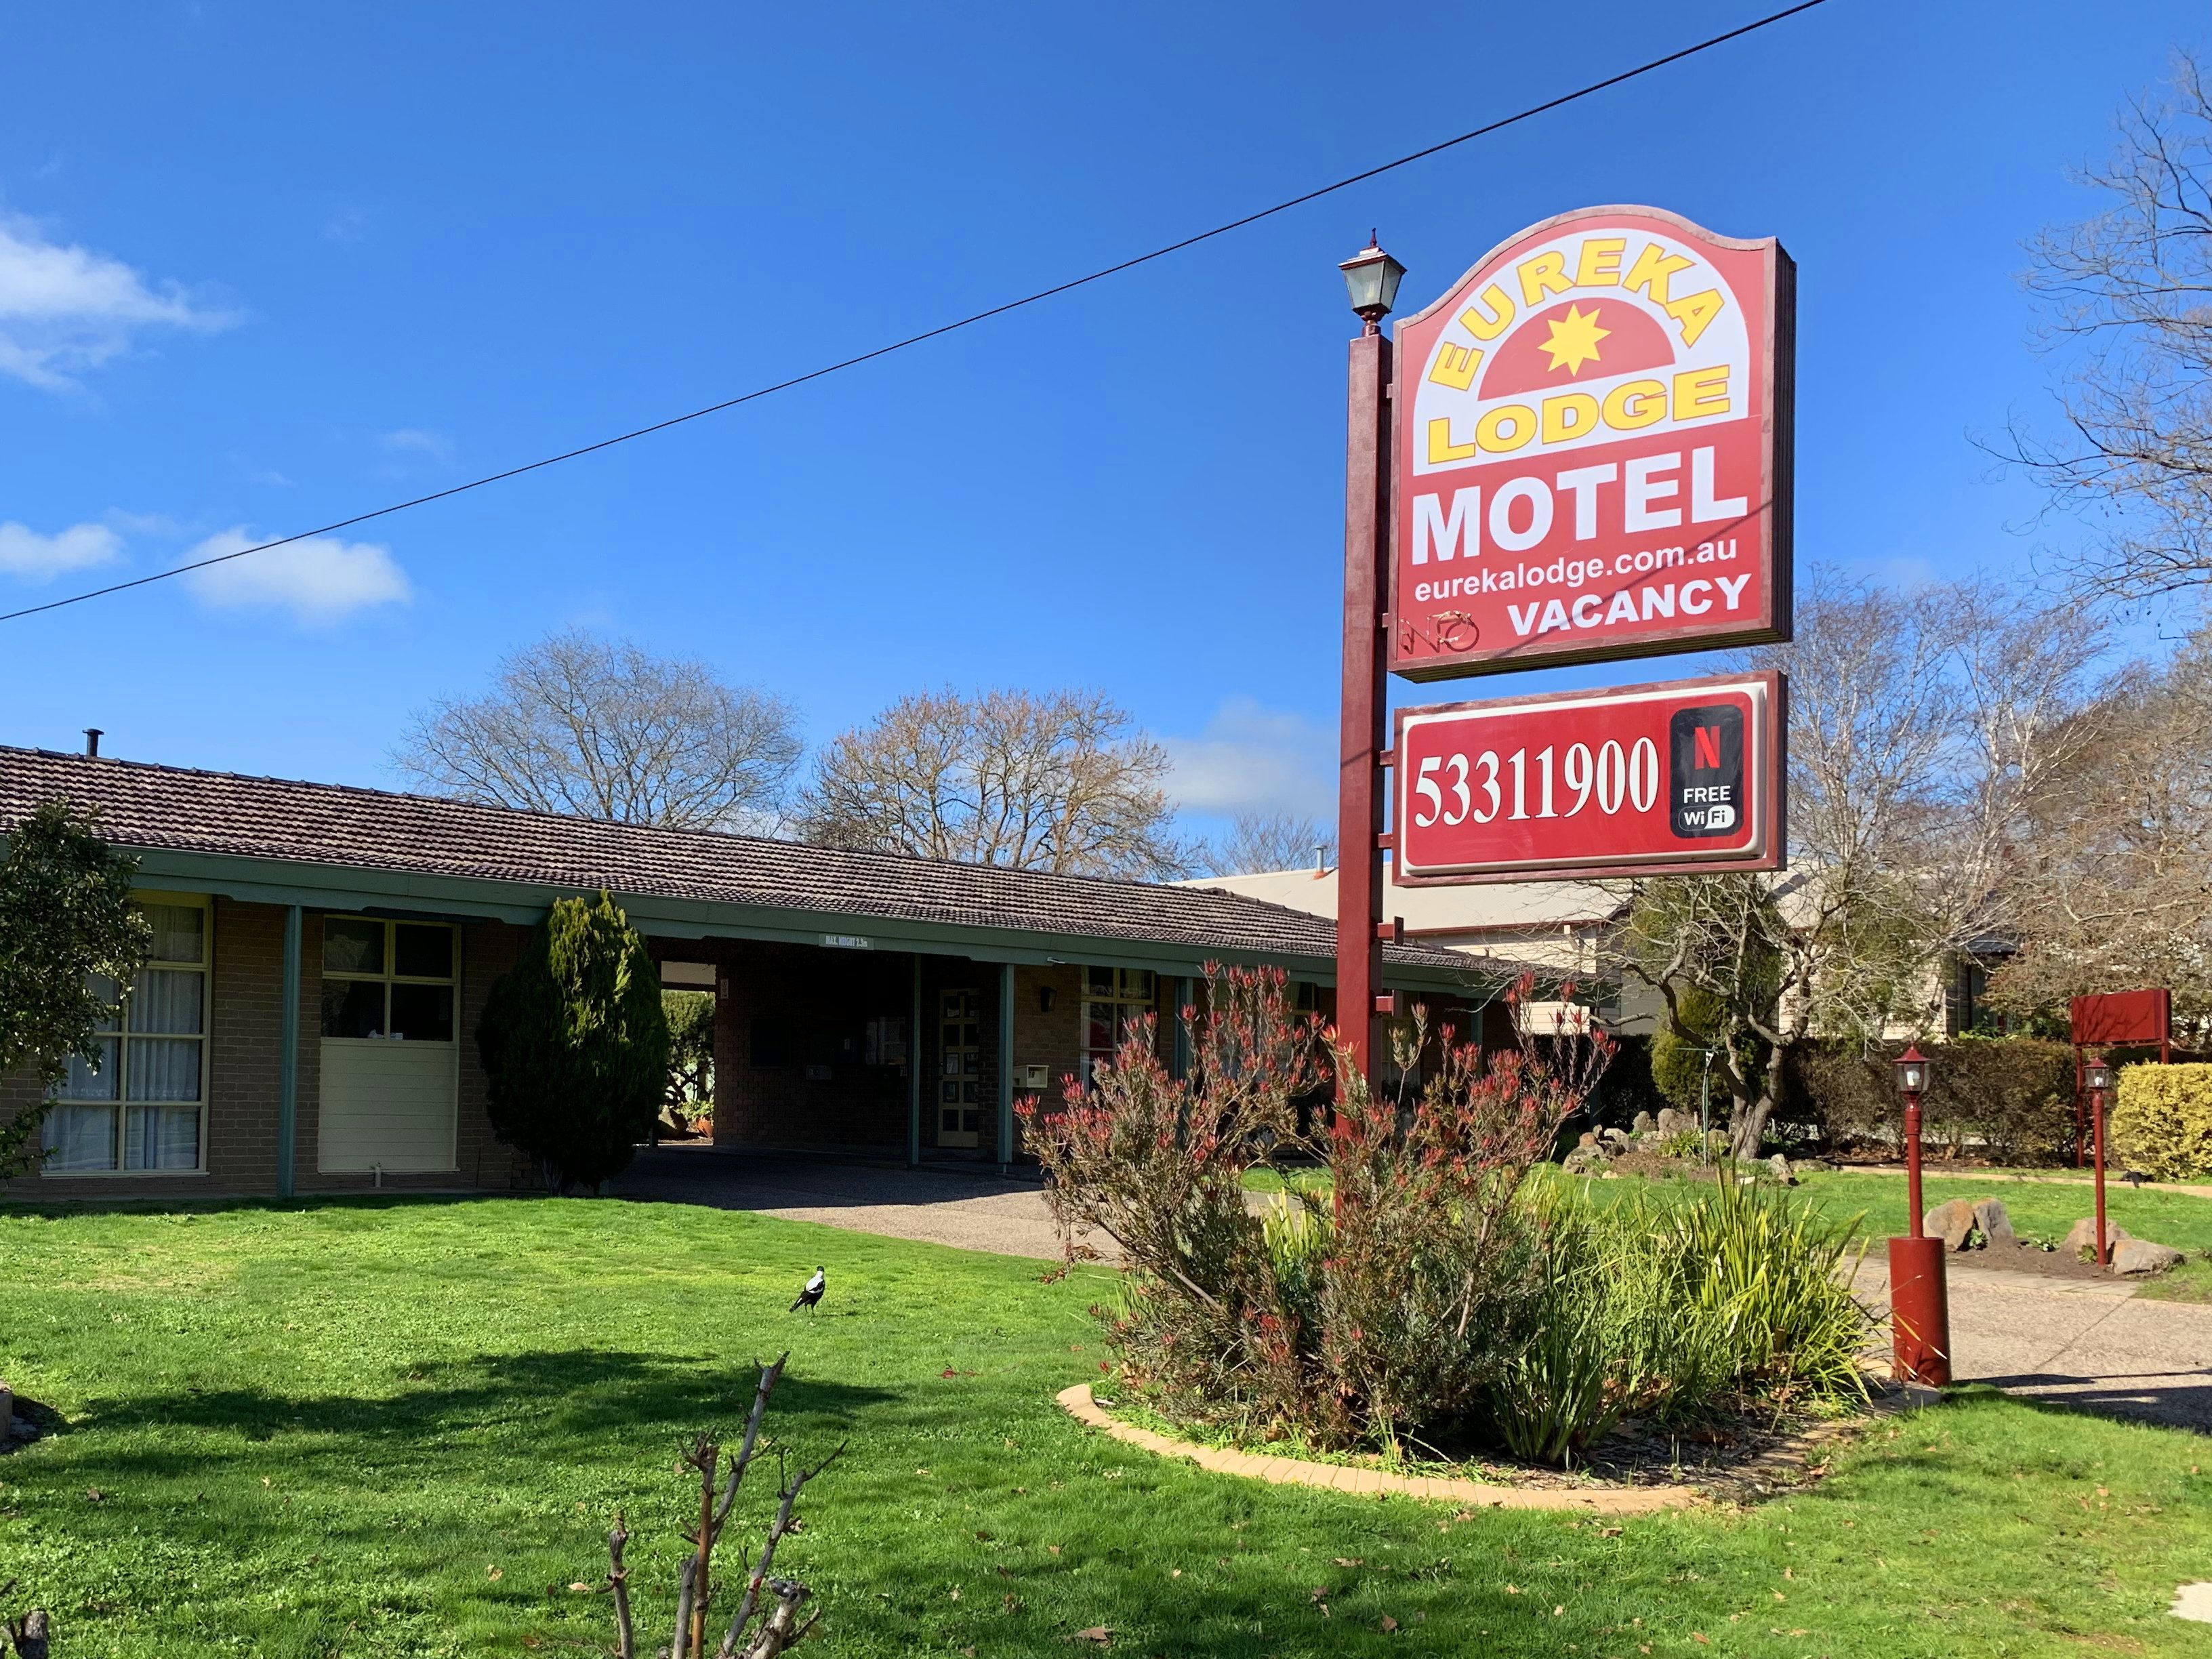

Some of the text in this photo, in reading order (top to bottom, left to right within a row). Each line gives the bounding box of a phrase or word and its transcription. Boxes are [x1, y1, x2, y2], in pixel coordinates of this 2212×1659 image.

[1428, 238, 1725, 392] EUREKA
[1427, 364, 1731, 466] LODGE
[1411, 445, 1748, 565] MOTEL
[1414, 537, 1737, 602] eurekalodge.com.au
[1507, 573, 1752, 636] VACANCY
[1414, 736, 1660, 828] 53311900
[1683, 785, 1732, 804] FREE
